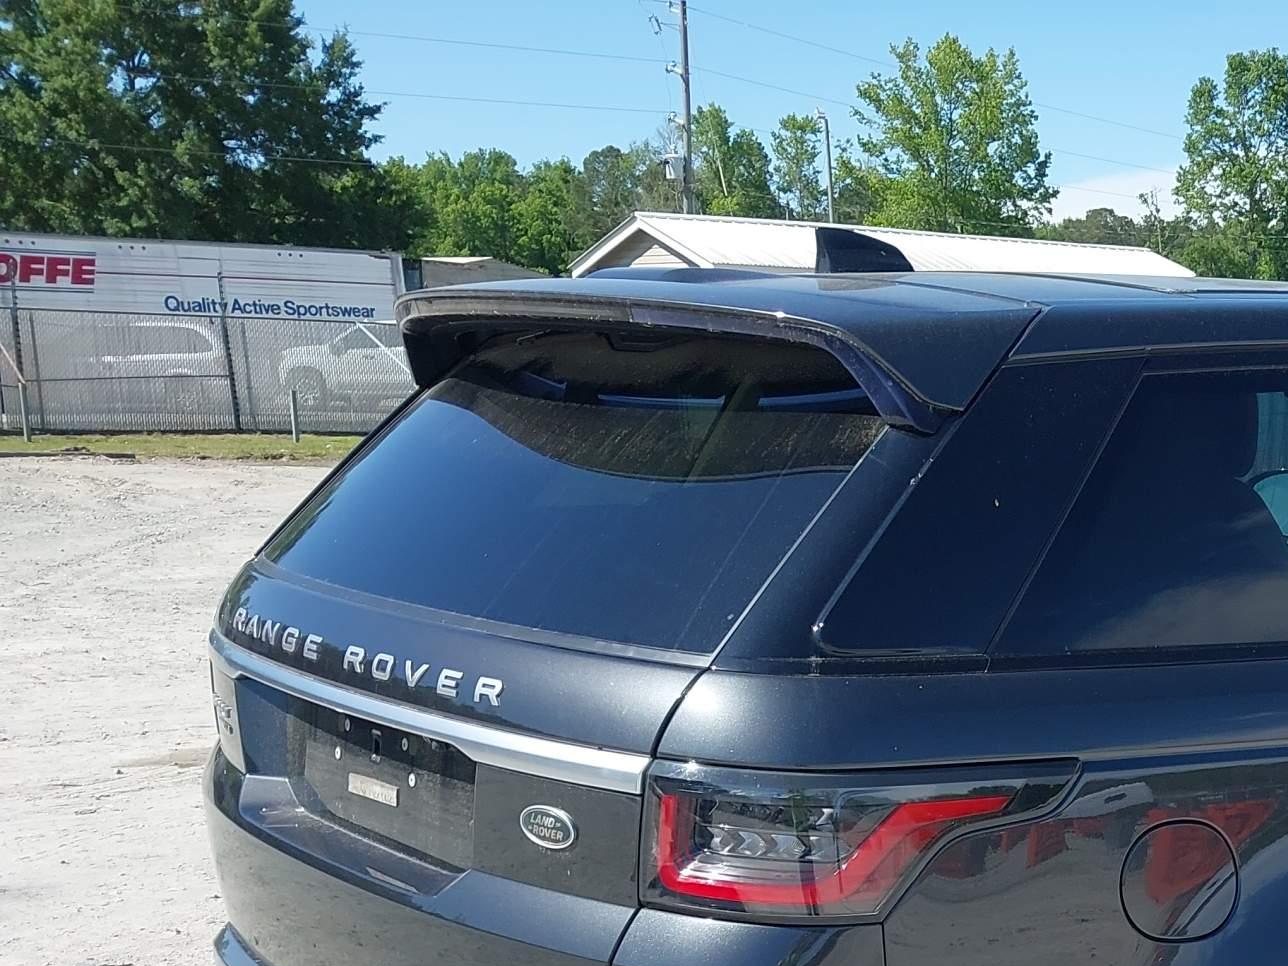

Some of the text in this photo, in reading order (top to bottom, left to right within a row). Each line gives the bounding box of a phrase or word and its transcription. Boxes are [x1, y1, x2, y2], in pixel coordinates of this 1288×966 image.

[164, 295, 375, 319] Quality Active Sportswear
[233, 607, 504, 706] RANGE ROVER
[530, 812, 556, 828] LAND
[532, 824, 564, 841] ROVER
